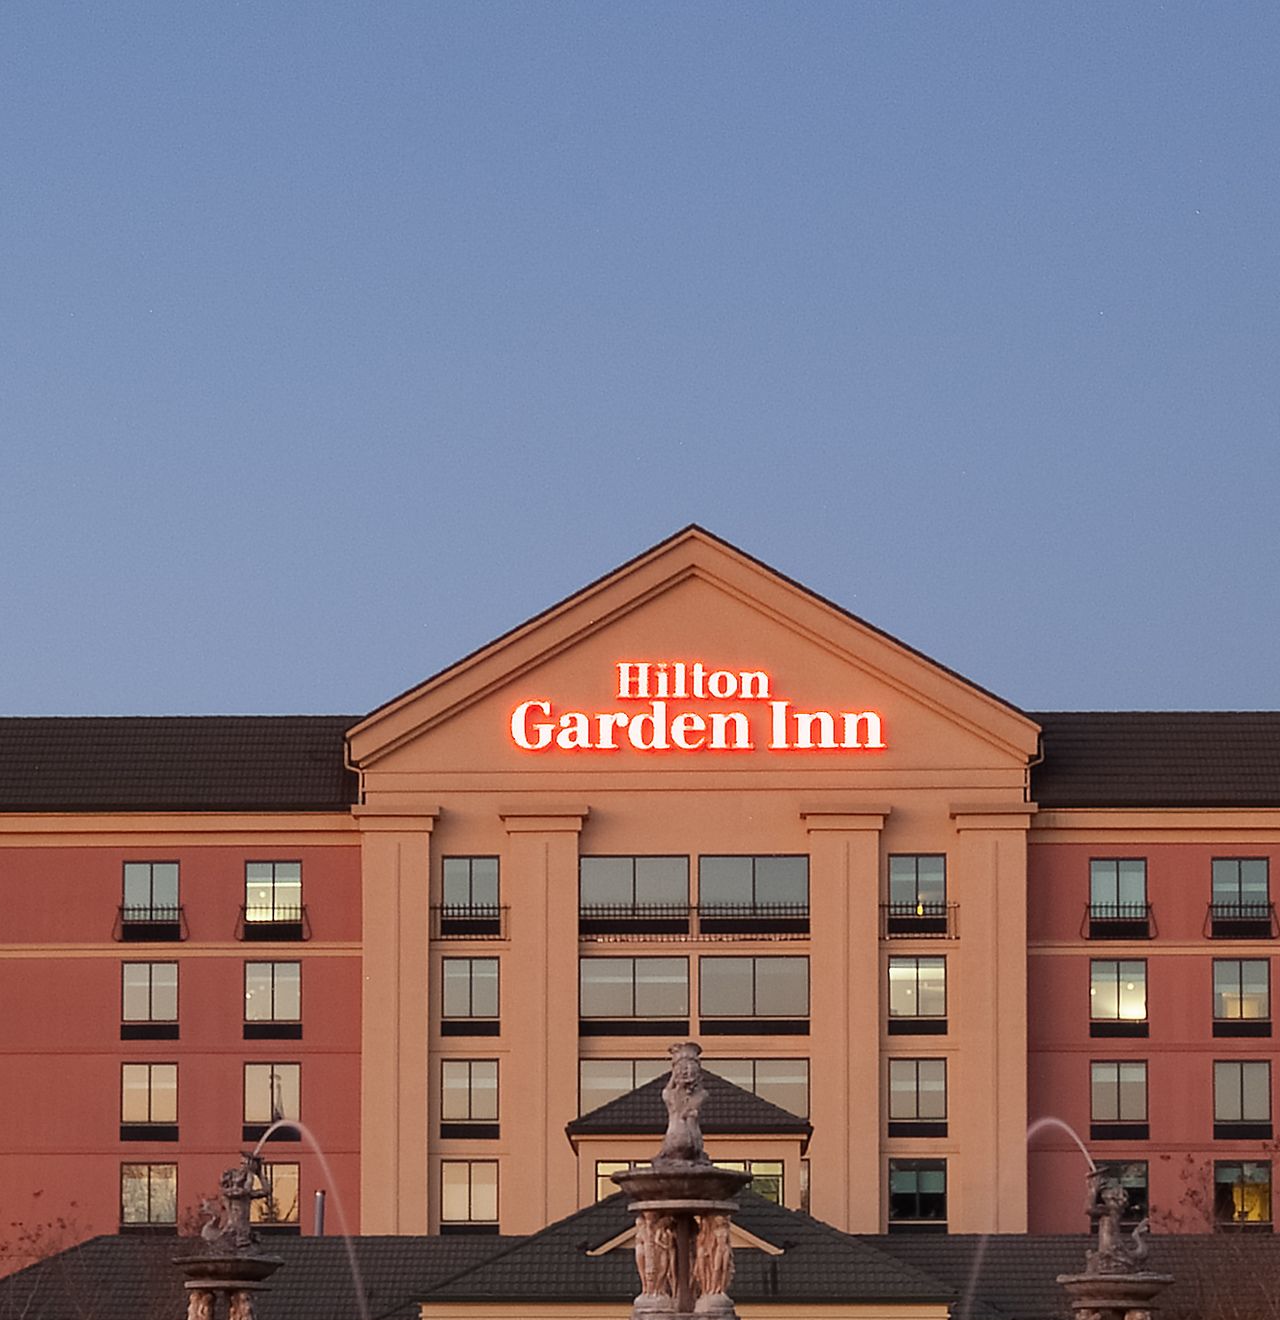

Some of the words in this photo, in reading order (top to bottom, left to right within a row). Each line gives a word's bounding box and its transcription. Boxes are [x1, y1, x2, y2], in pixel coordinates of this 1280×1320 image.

[617, 662, 770, 699] Hilton
[511, 701, 754, 750] Garden
[768, 701, 886, 750] Inn
